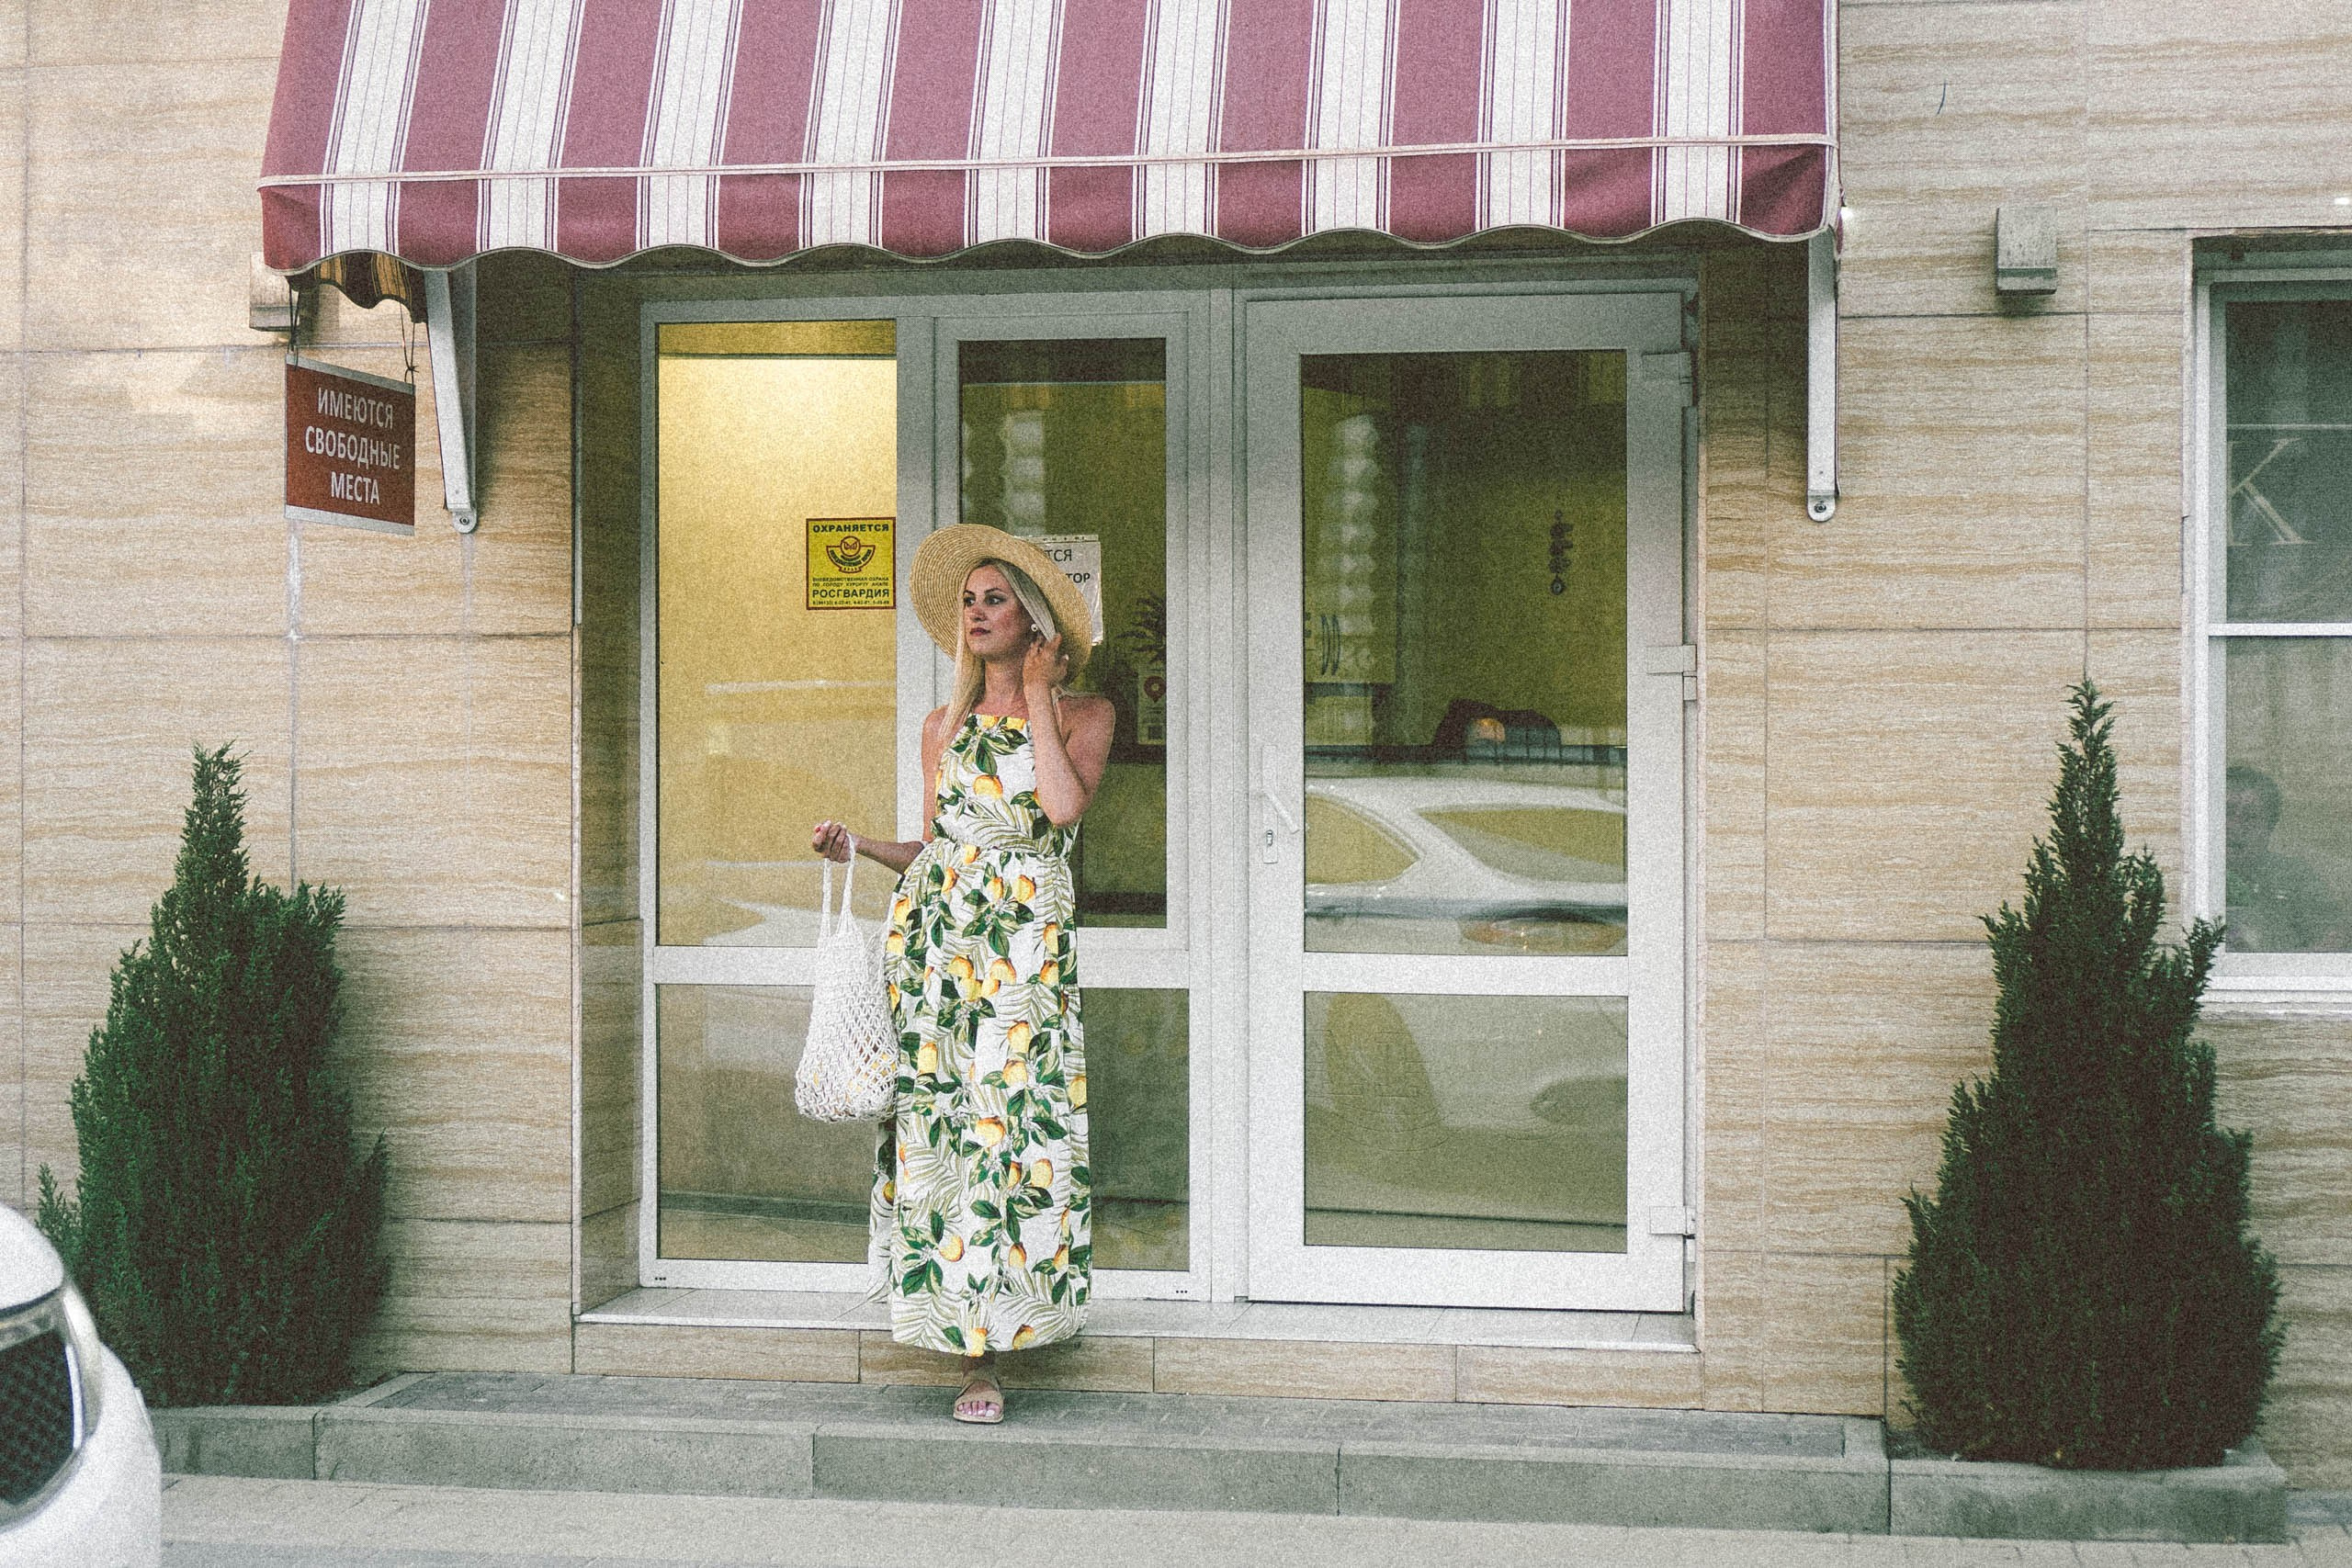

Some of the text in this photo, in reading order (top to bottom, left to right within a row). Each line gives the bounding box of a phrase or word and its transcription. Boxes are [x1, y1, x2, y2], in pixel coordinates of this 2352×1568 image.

[318, 387, 393, 429] ИМЕЮТСЯ
[305, 425, 400, 470] СВОБОДНЫЕ
[331, 471, 380, 505] МЕСТА
[812, 524, 889, 533] ОХРАНЯЕТСЯ
[1044, 548, 1072, 562] ТСЯ
[1065, 572, 1091, 583] ТОР
[812, 589, 889, 599] РОСГВАРДИЯ
